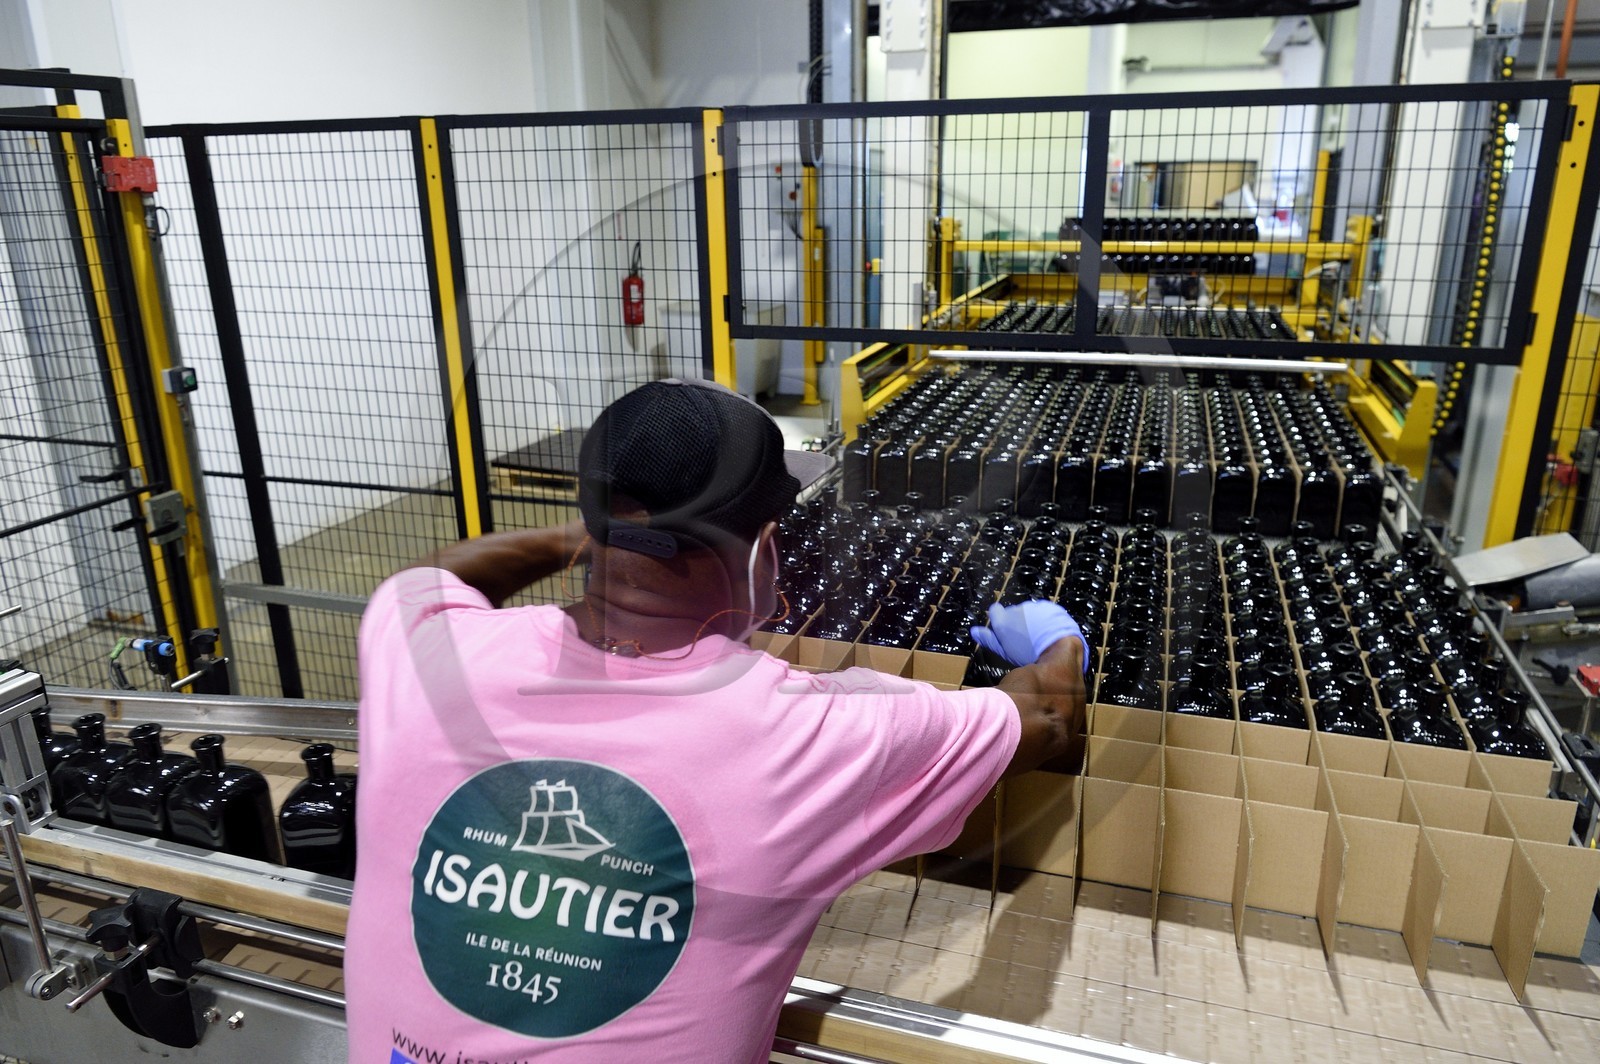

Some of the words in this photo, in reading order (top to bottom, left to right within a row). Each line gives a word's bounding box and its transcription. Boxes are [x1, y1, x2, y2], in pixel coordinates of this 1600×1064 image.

[463, 826, 508, 847] RHUM
[600, 854, 654, 876] PUNCH
[423, 849, 679, 942] ISAUTIER
[465, 932, 488, 948] ILE
[491, 937, 511, 953] DE
[513, 942, 531, 958] LA
[535, 947, 602, 971] RÉUNION
[486, 960, 562, 1004] 1845
